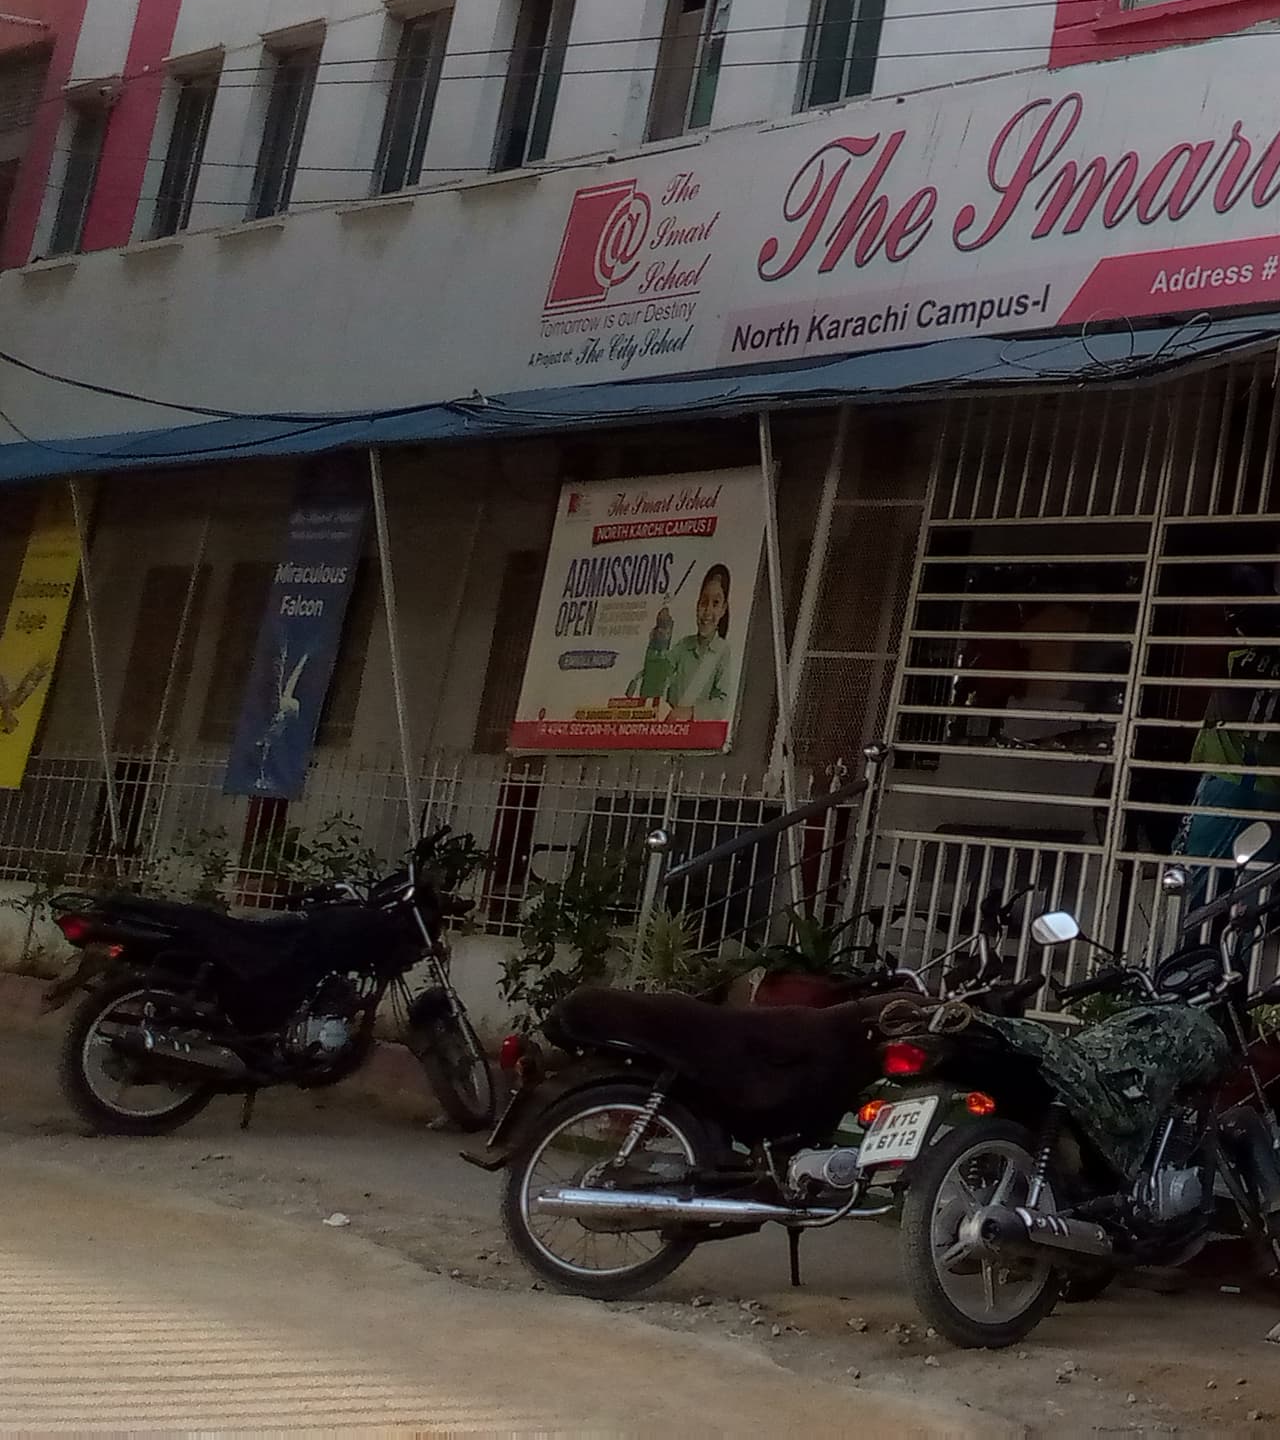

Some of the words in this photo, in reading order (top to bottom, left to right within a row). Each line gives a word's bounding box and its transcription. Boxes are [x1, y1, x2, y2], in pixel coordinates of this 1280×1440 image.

[661, 171, 701, 207] The
[757, 129, 939, 282] The
[649, 211, 721, 250] Smart
[638, 253, 712, 295] School
[1150, 262, 1254, 295] Address
[1262, 256, 1279, 281] #
[540, 317, 600, 339] Tomorrow
[603, 314, 615, 329] is
[617, 310, 640, 328] our
[643, 301, 697, 323] Destiny
[729, 312, 800, 354] North
[805, 303, 910, 345] Karachi
[608, 334, 636, 371] City
[638, 324, 695, 358] School
[274, 561, 348, 585] Miraculous
[562, 552, 674, 599] ADMISSIONS
[280, 593, 324, 617] Falcon
[554, 600, 598, 637] OPEN
[876, 1130, 917, 1150] 6712
